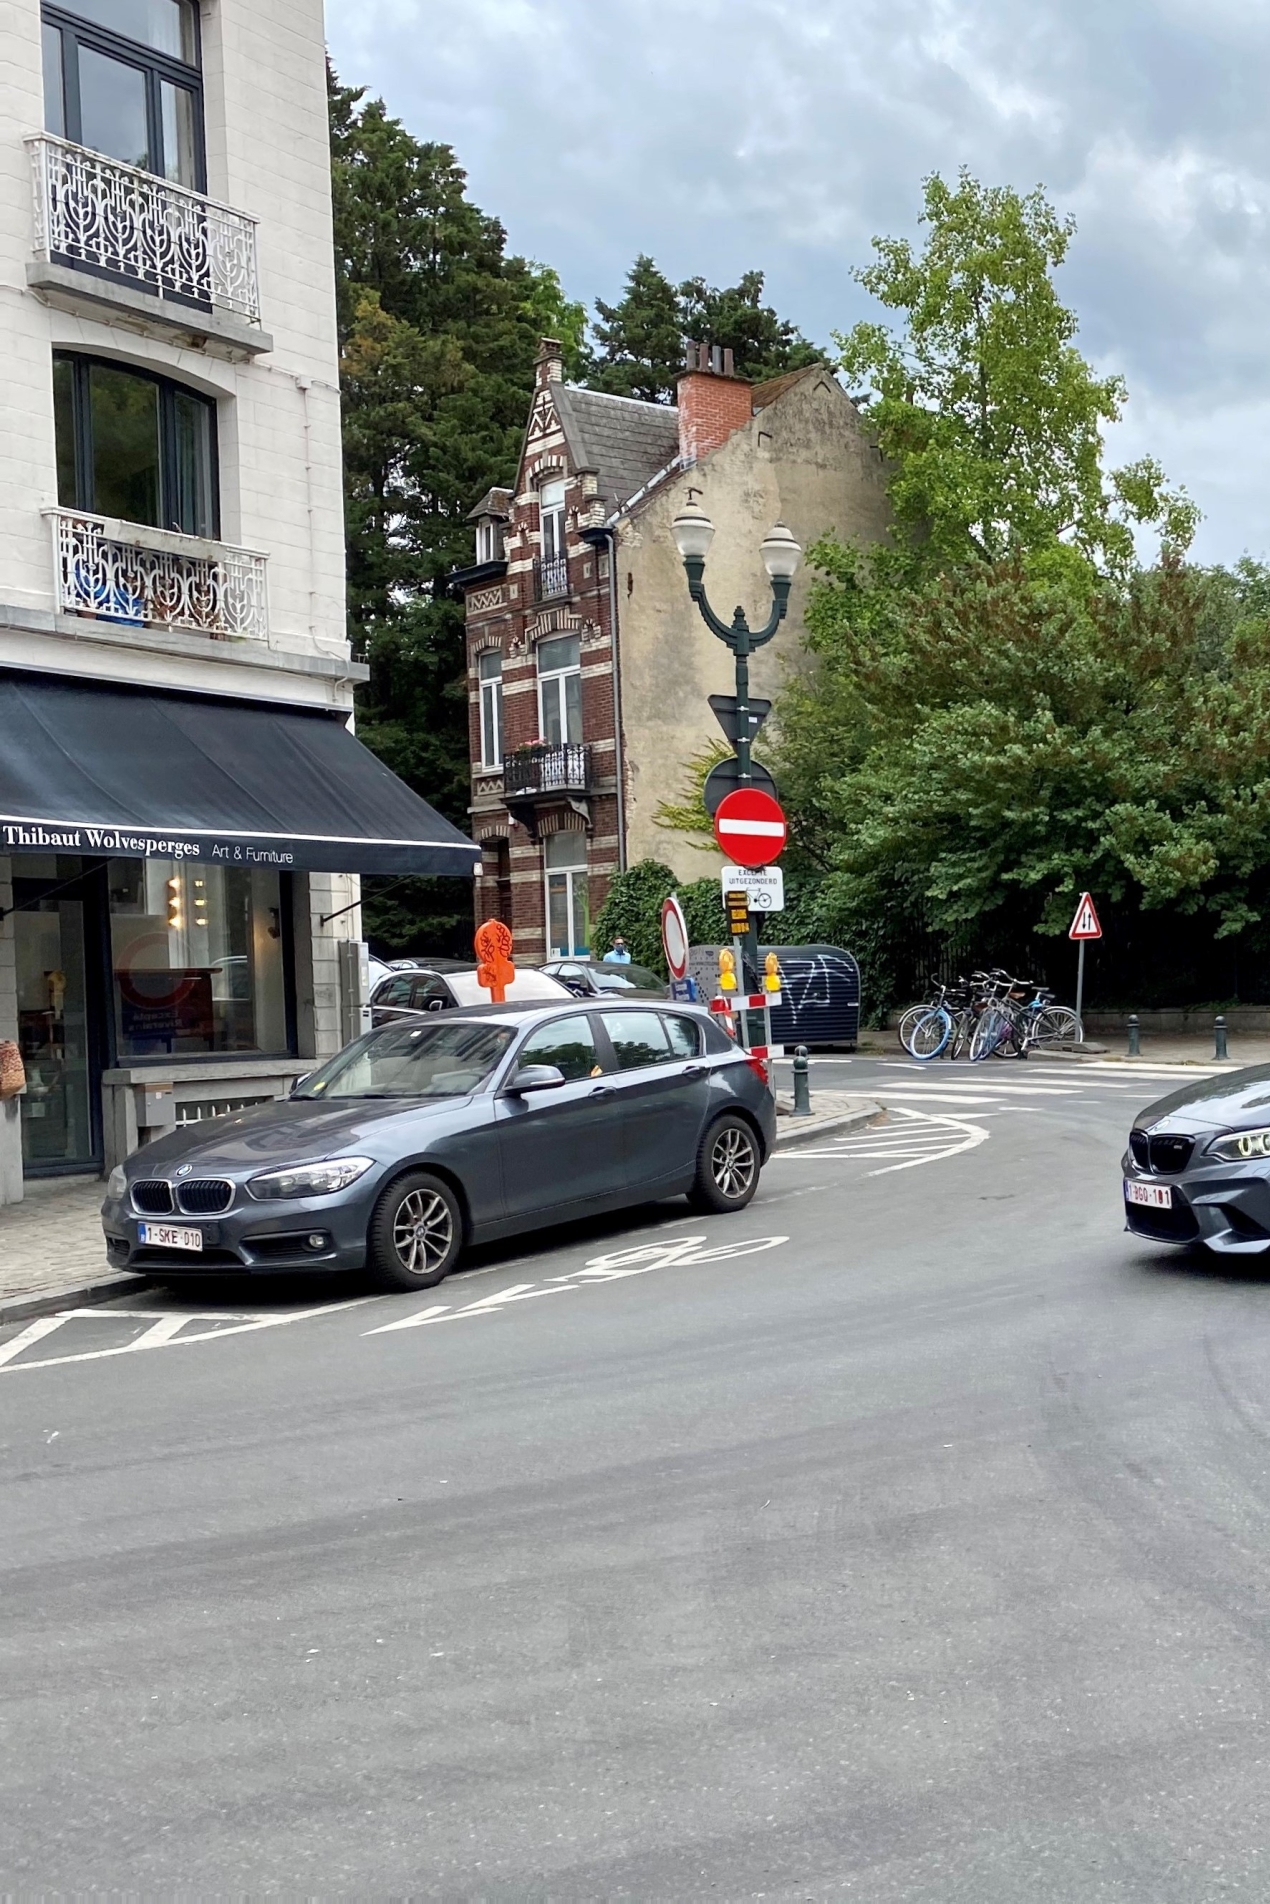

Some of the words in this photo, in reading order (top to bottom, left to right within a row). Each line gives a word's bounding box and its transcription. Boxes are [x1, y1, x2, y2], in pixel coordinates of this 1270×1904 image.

[3, 825, 81, 847] Thibaut
[84, 828, 200, 859] Wolvesperges
[211, 844, 229, 859] Art
[233, 846, 243, 860] &
[246, 848, 294, 864] Furniture
[729, 877, 778, 885] UITGEZONDERD
